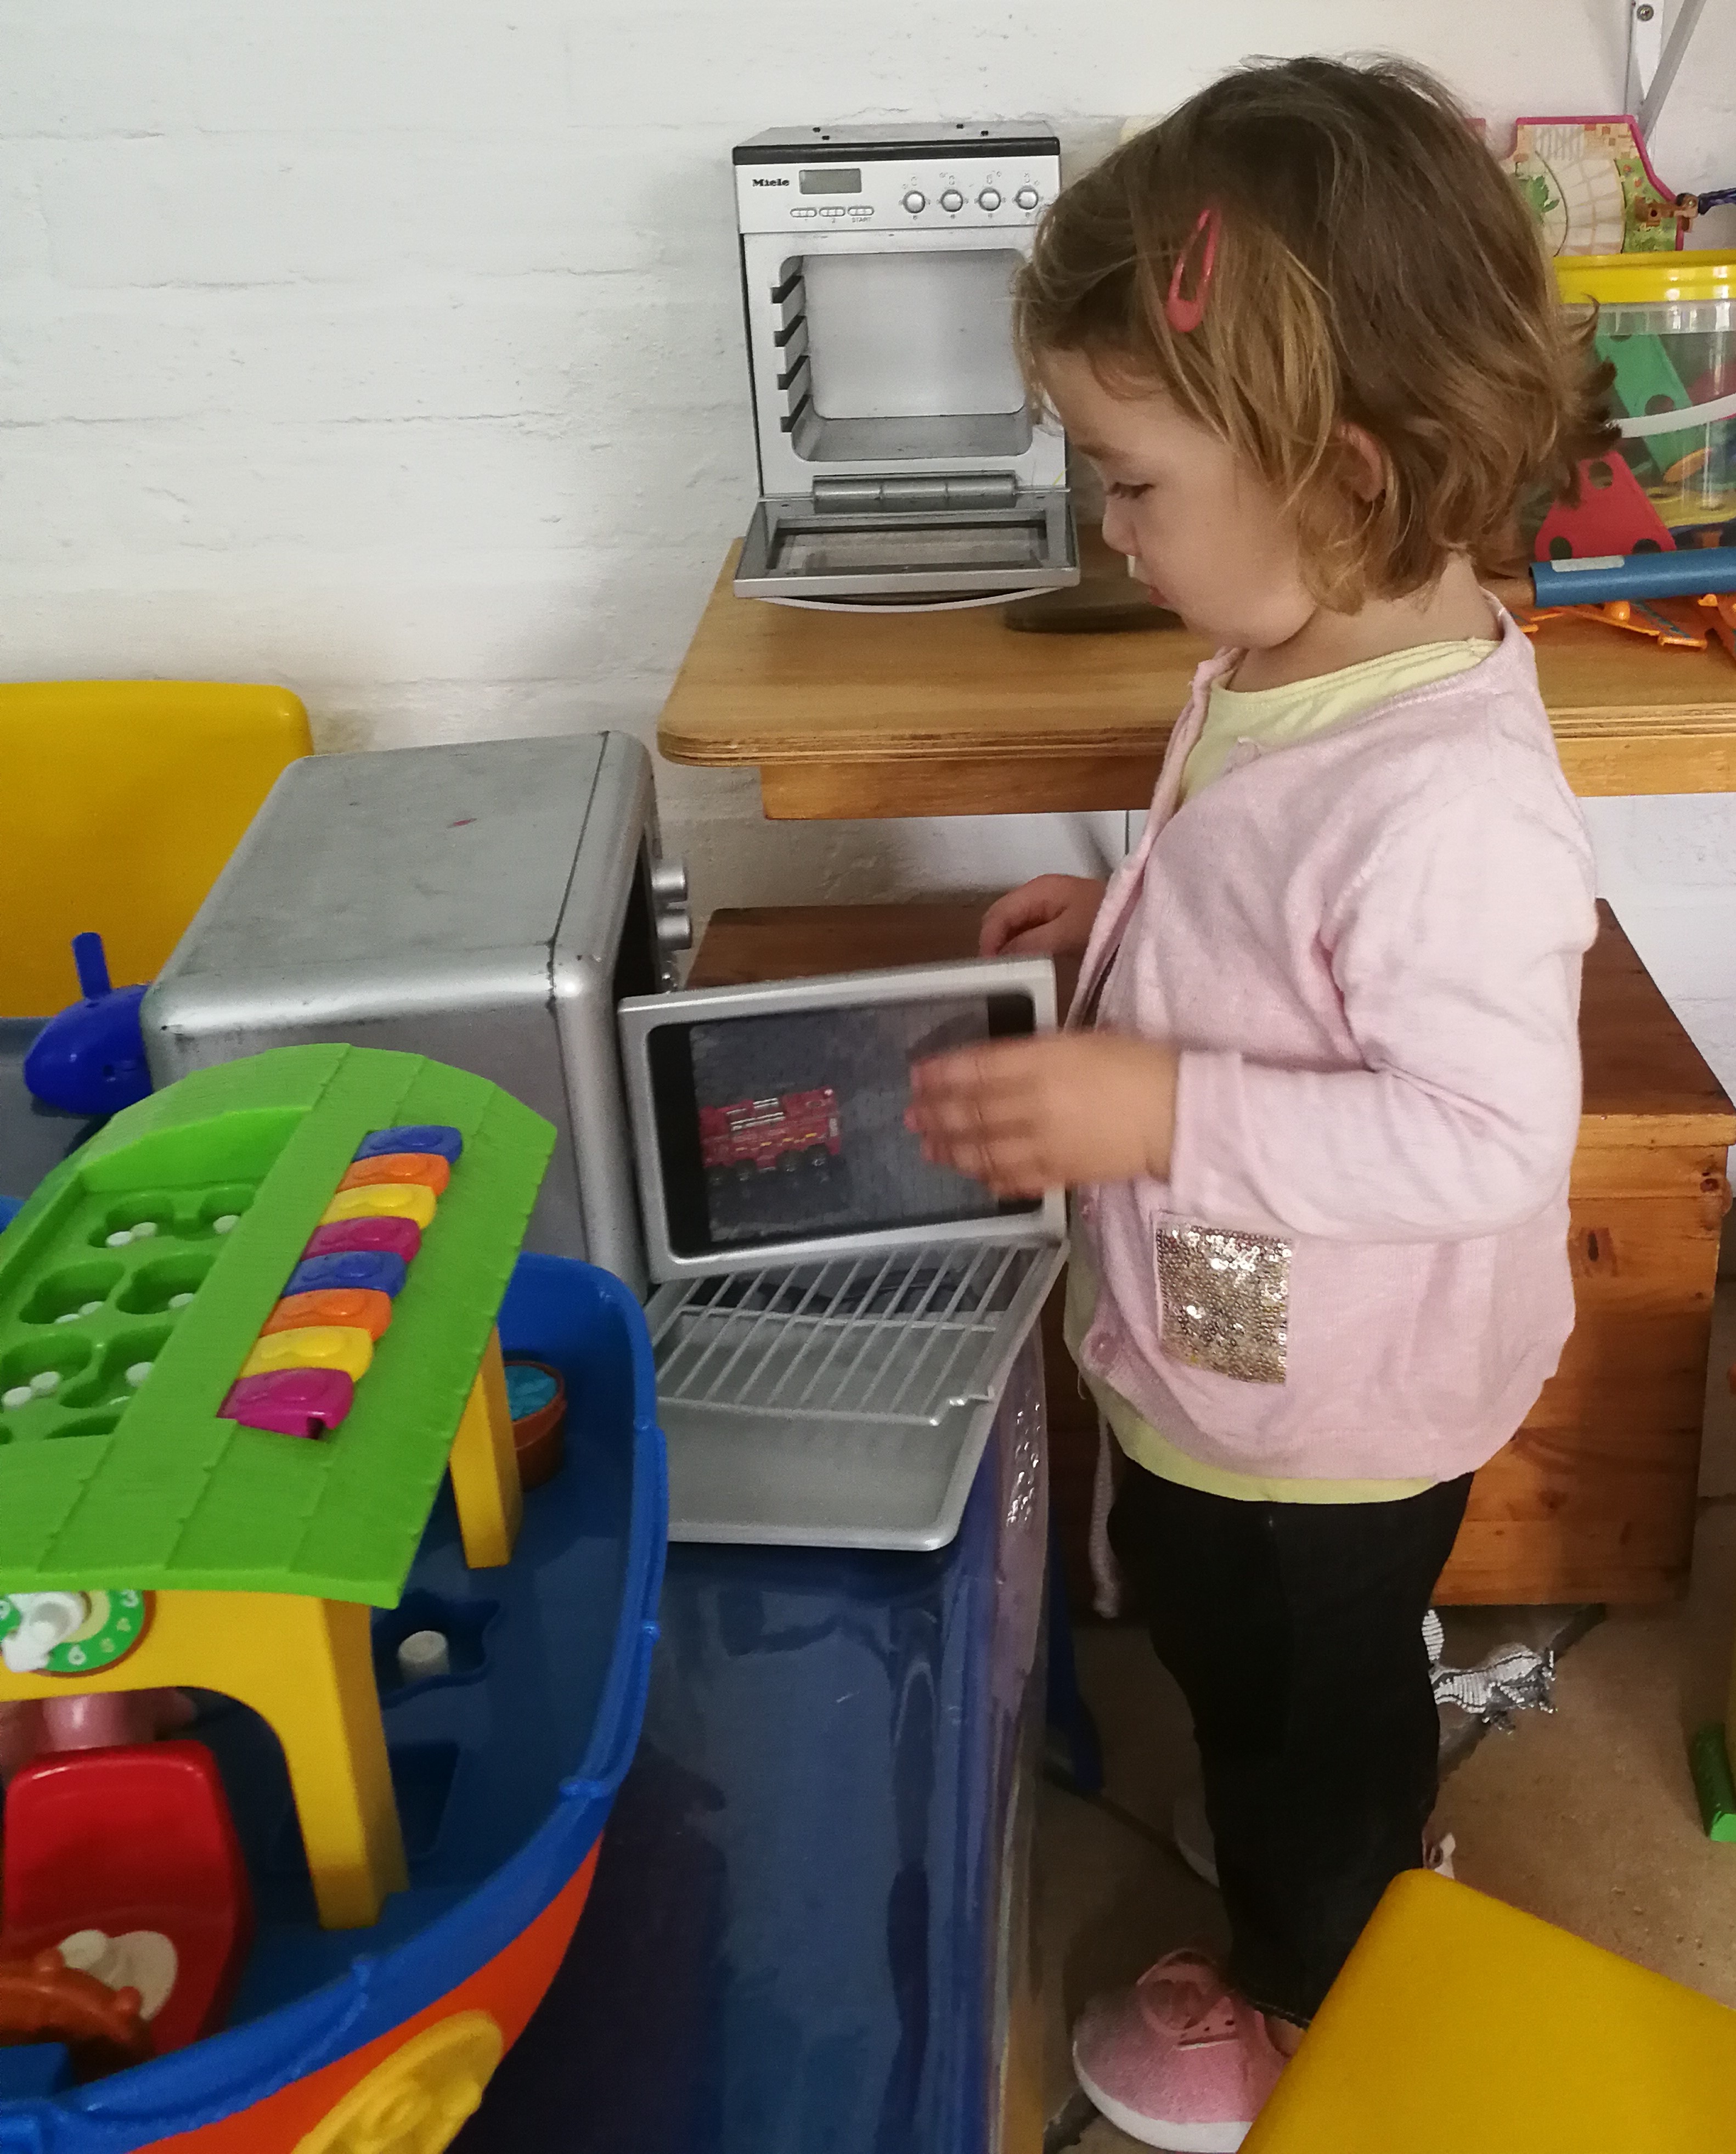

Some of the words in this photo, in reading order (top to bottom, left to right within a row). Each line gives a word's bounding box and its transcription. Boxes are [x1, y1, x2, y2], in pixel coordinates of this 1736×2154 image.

[752, 179, 790, 187] Miele
[120, 1589, 139, 1609] 3
[67, 1644, 87, 1666] 6
